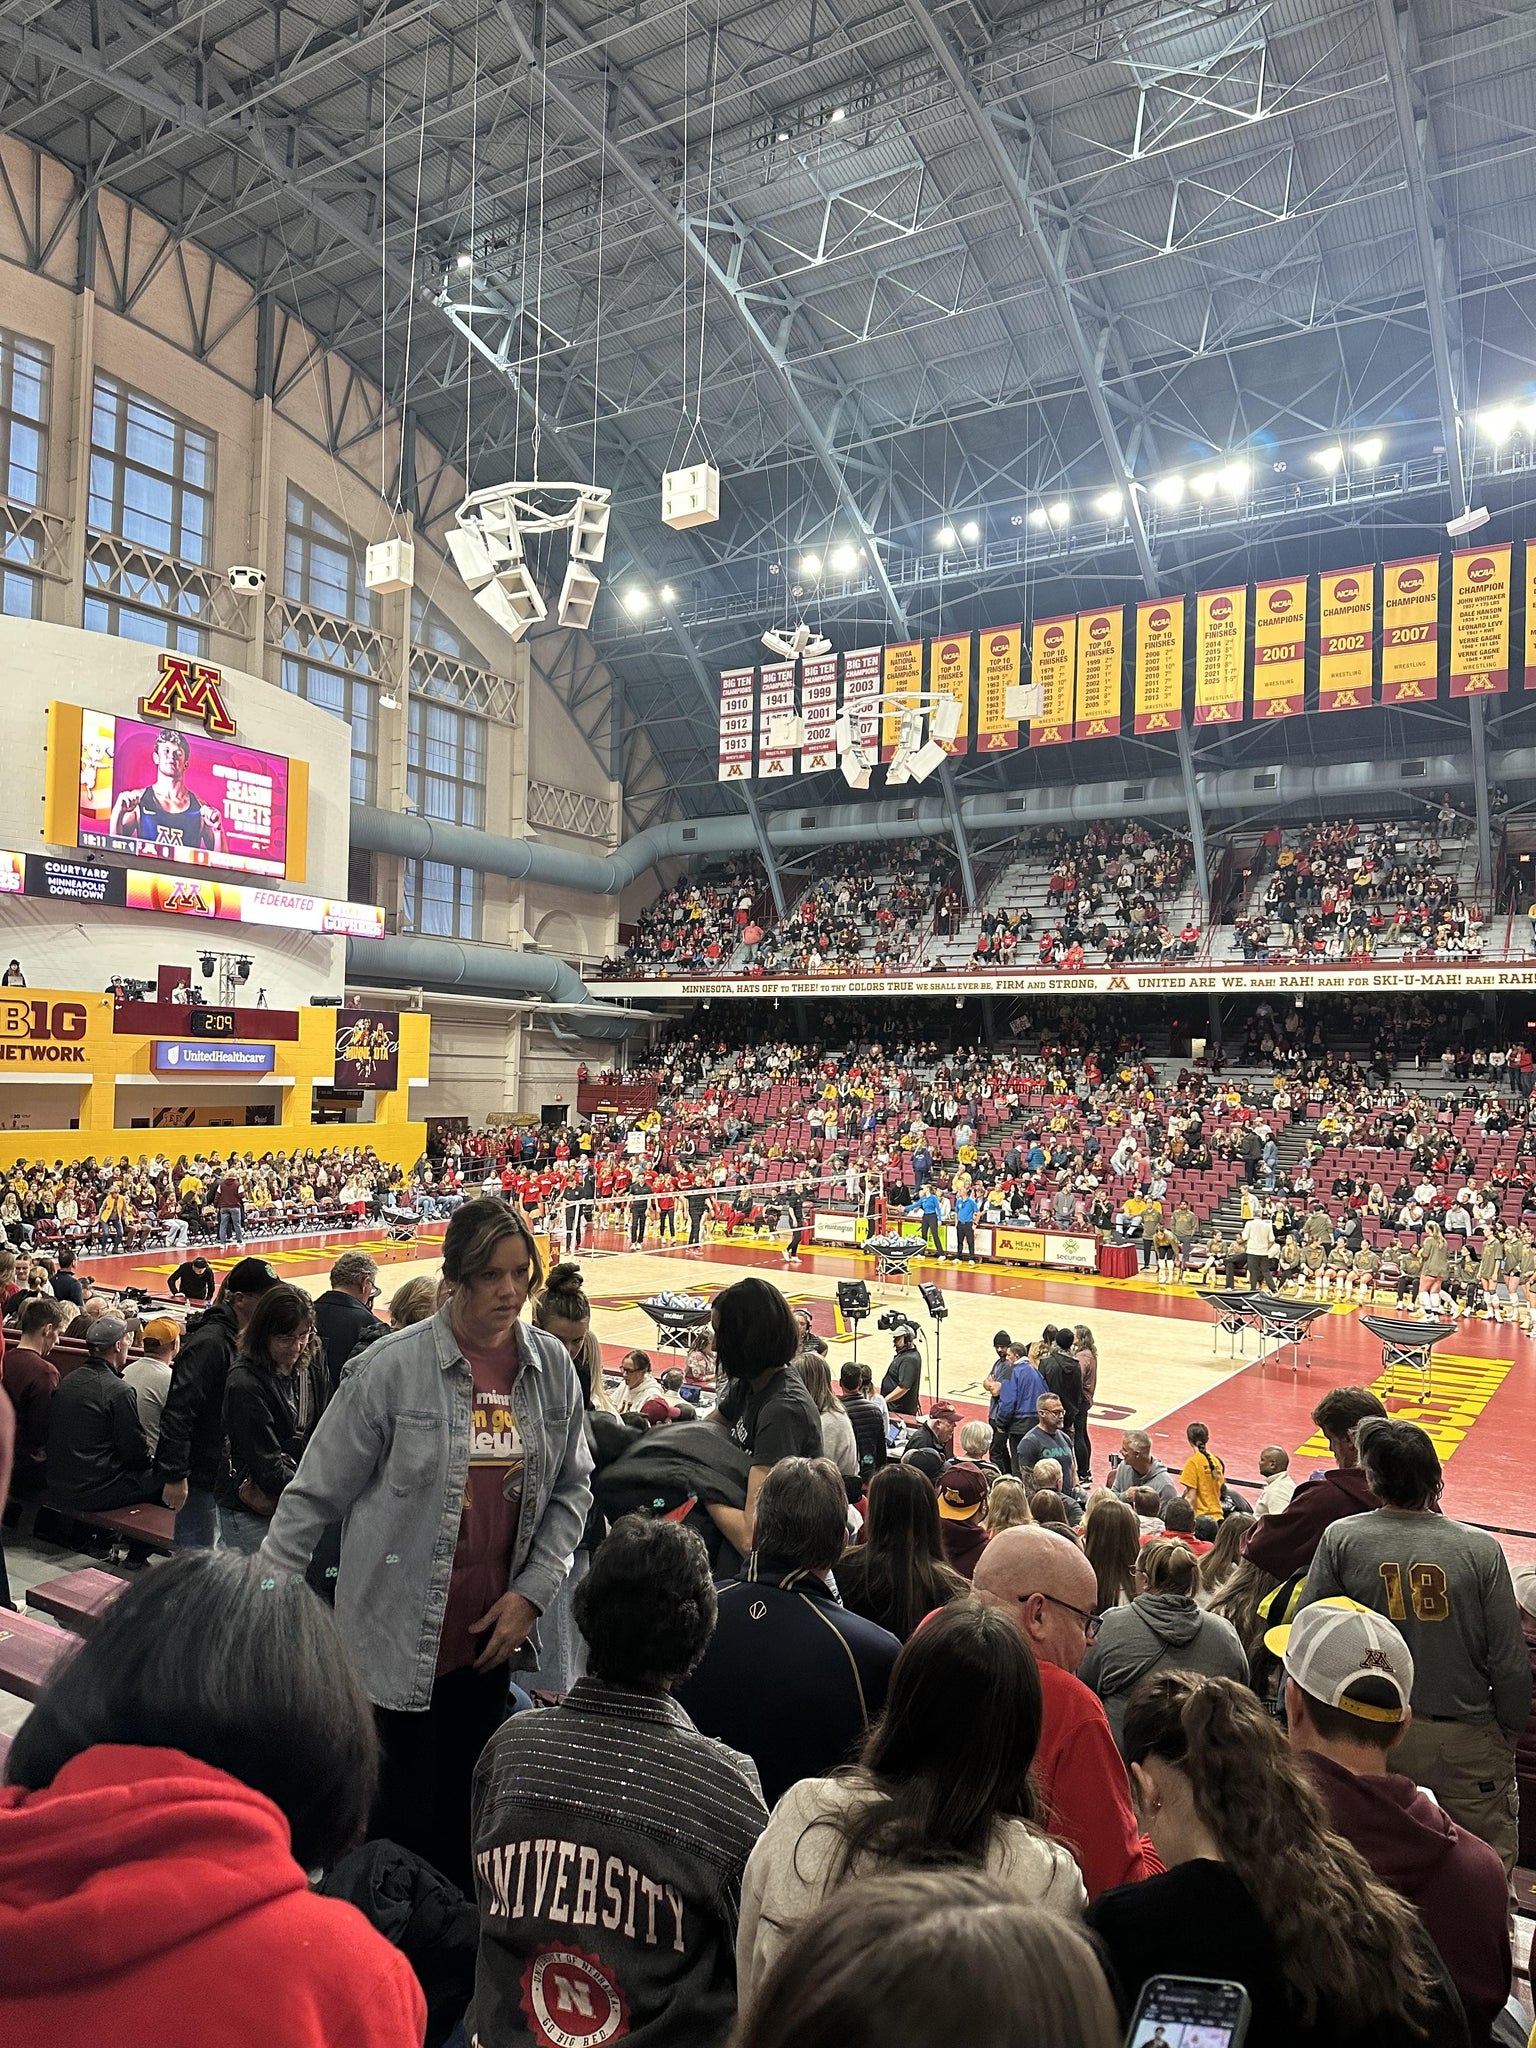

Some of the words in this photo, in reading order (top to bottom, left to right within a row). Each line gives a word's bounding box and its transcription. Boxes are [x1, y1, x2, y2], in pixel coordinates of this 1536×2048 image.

[1470, 568, 1495, 578] NCAA
[1400, 579, 1424, 588] NCAA
[1459, 582, 1504, 595] CHAMPION
[1337, 589, 1358, 598] NCAA
[1475, 593, 1505, 602] WHITAKER
[1271, 600, 1292, 608] NCAA
[1386, 594, 1436, 608] CHAMPIONS
[1212, 607, 1231, 616] NCAA
[1324, 603, 1371, 617] CHAMPIONS
[1460, 610, 1476, 618] DALE
[1477, 607, 1502, 615] HANSON
[1151, 619, 1170, 627] NCAA
[1258, 614, 1303, 627] CHAMPIONS
[1092, 627, 1110, 636] NCAA
[1209, 623, 1222, 631] TOP
[1458, 623, 1486, 631] LEONARD
[1205, 628, 1237, 639] FINISHES
[1392, 626, 1429, 643] 2007
[1481, 634, 1501, 642] GAGNE
[1046, 636, 1064, 644] NCAA
[1145, 639, 1175, 649] FINISHES
[1329, 636, 1364, 652] 2002
[896, 650, 912, 658] NWCA
[1086, 648, 1114, 657] FINISHES
[1263, 645, 1295, 661] 2001
[847, 660, 860, 670] BIG
[862, 656, 878, 667] TEN
[1040, 656, 1068, 666] FINISHES
[1463, 662, 1496, 670] WRESTLING
[805, 666, 818, 676] BIG
[820, 664, 835, 674] TEN
[846, 667, 878, 677] CHAMPIONS
[987, 664, 1013, 673] FINISHES
[1331, 670, 1361, 678] WRESTLING
[763, 673, 776, 683] BIG
[778, 671, 792, 680] TEN
[804, 674, 835, 684] CHAMPIONS
[887, 670, 919, 680] CHAMPIONS
[938, 672, 963, 680] FINISHES
[723, 678, 736, 688] BIG
[737, 676, 751, 686] TEN
[763, 680, 792, 691] CHAMPIONS
[850, 680, 873, 693] 2003
[1265, 679, 1294, 687] WRESTLING
[723, 686, 751, 696] CHAMPIONS
[808, 687, 831, 699] 1999
[726, 699, 748, 710] 1910
[767, 693, 788, 705] 1941
[808, 707, 830, 720] 2001
[726, 719, 747, 730] 1912
[808, 728, 830, 740] 2002
[726, 739, 747, 750] 1913
[223, 799, 271, 826] TICKETS
[45, 862, 107, 879] COURTYARD
[48, 877, 106, 892] MINNEAPOLIS
[50, 885, 104, 900] DOWNTOWN
[254, 892, 314, 911] FEDERATED
[682, 985, 734, 994] MINNESOTA,
[736, 984, 760, 993] HATS
[762, 984, 778, 992] OFF
[792, 984, 818, 992] THEE!
[849, 983, 884, 991] COLORS
[887, 982, 913, 990] TRUE
[958, 982, 979, 990] EVER
[981, 982, 993, 990] BE,
[996, 981, 1024, 990] FIRM
[1049, 979, 1097, 990] STRONG,
[1138, 978, 1186, 988] UNITED
[1189, 978, 1216, 987] ARE
[1222, 978, 1247, 987] WE.
[1250, 979, 1275, 987] RAH!
[1280, 977, 1314, 986] RAH!
[1318, 978, 1344, 986] RAH!
[1348, 978, 1368, 986] FOR
[1373, 974, 1461, 985] SKI-U-MAH!
[1466, 976, 1495, 984] RAH!
[205, 1015, 233, 1030] 2:09
[183, 1050, 265, 1064] UnitedHealthcare
[1015, 1240, 1040, 1248] HEALTH
[1056, 1254, 1086, 1262] securian
[1379, 1562, 1450, 1622] 18
[567, 1955, 577, 1963] OF
[554, 1973, 593, 2018] N
[543, 2018, 555, 2033] GO
[557, 2033, 575, 2046] BIG
